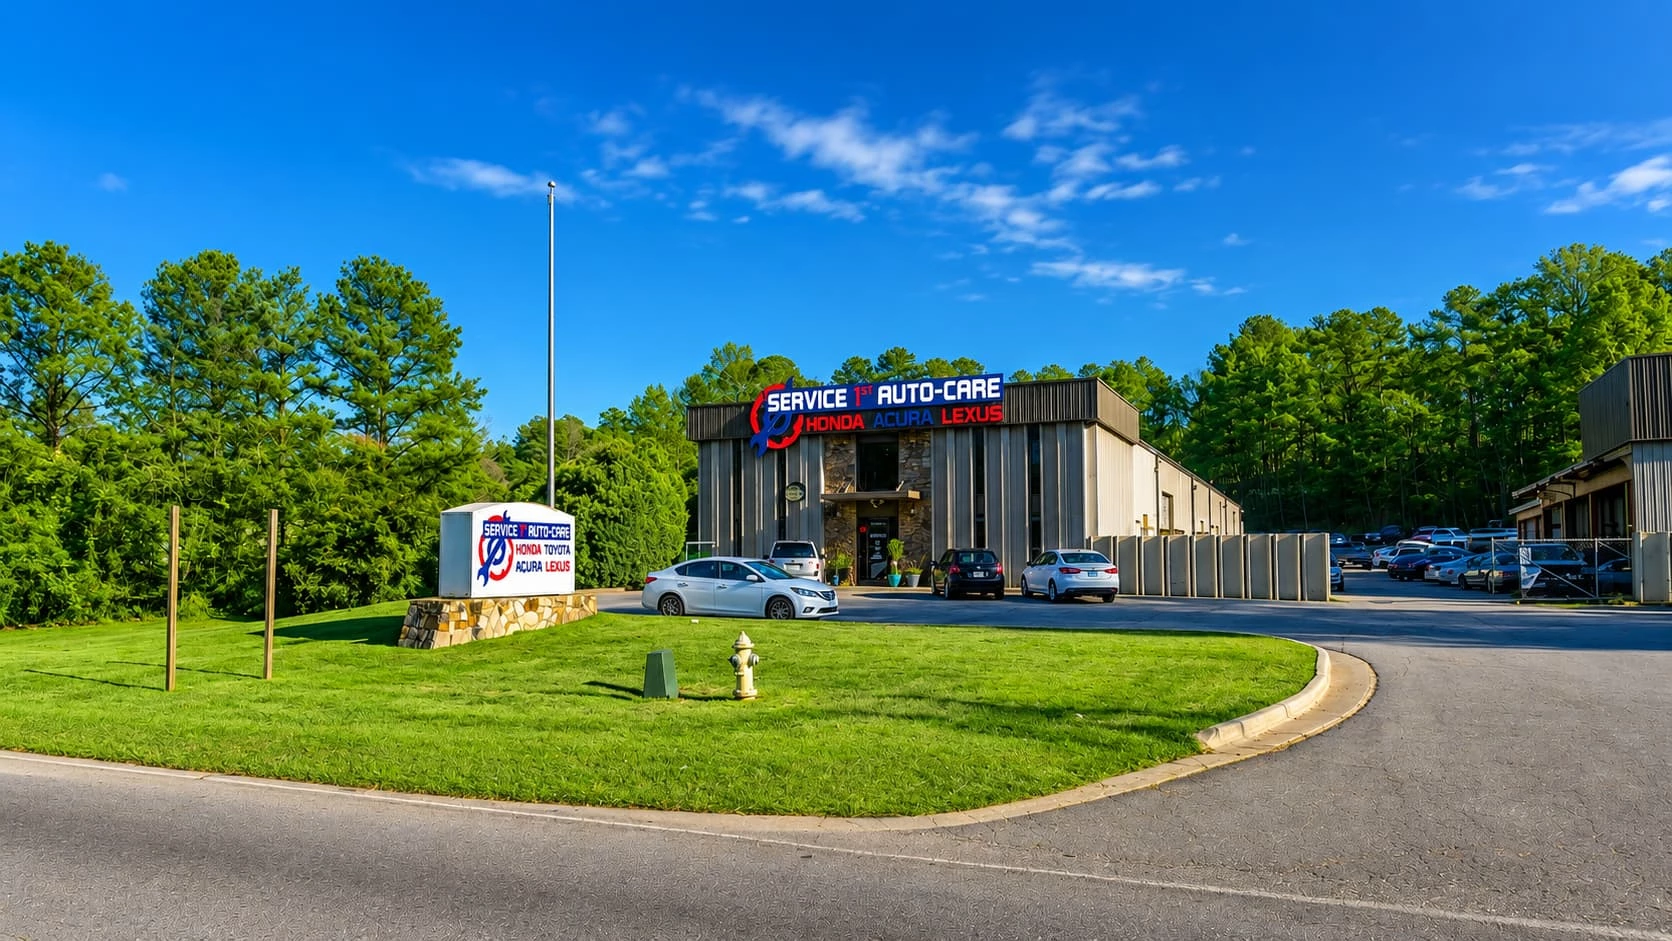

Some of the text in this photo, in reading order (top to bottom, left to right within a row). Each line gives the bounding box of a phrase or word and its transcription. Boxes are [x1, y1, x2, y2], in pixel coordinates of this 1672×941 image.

[768, 377, 1001, 412] SERVICE 1ST AUTO-CARE
[806, 405, 1003, 432] HONDA ACURA LEXUS
[484, 524, 517, 537] SERVICE
[516, 544, 570, 555] HONDA TOYOTA
[515, 561, 570, 572] ACURA LEXUS
